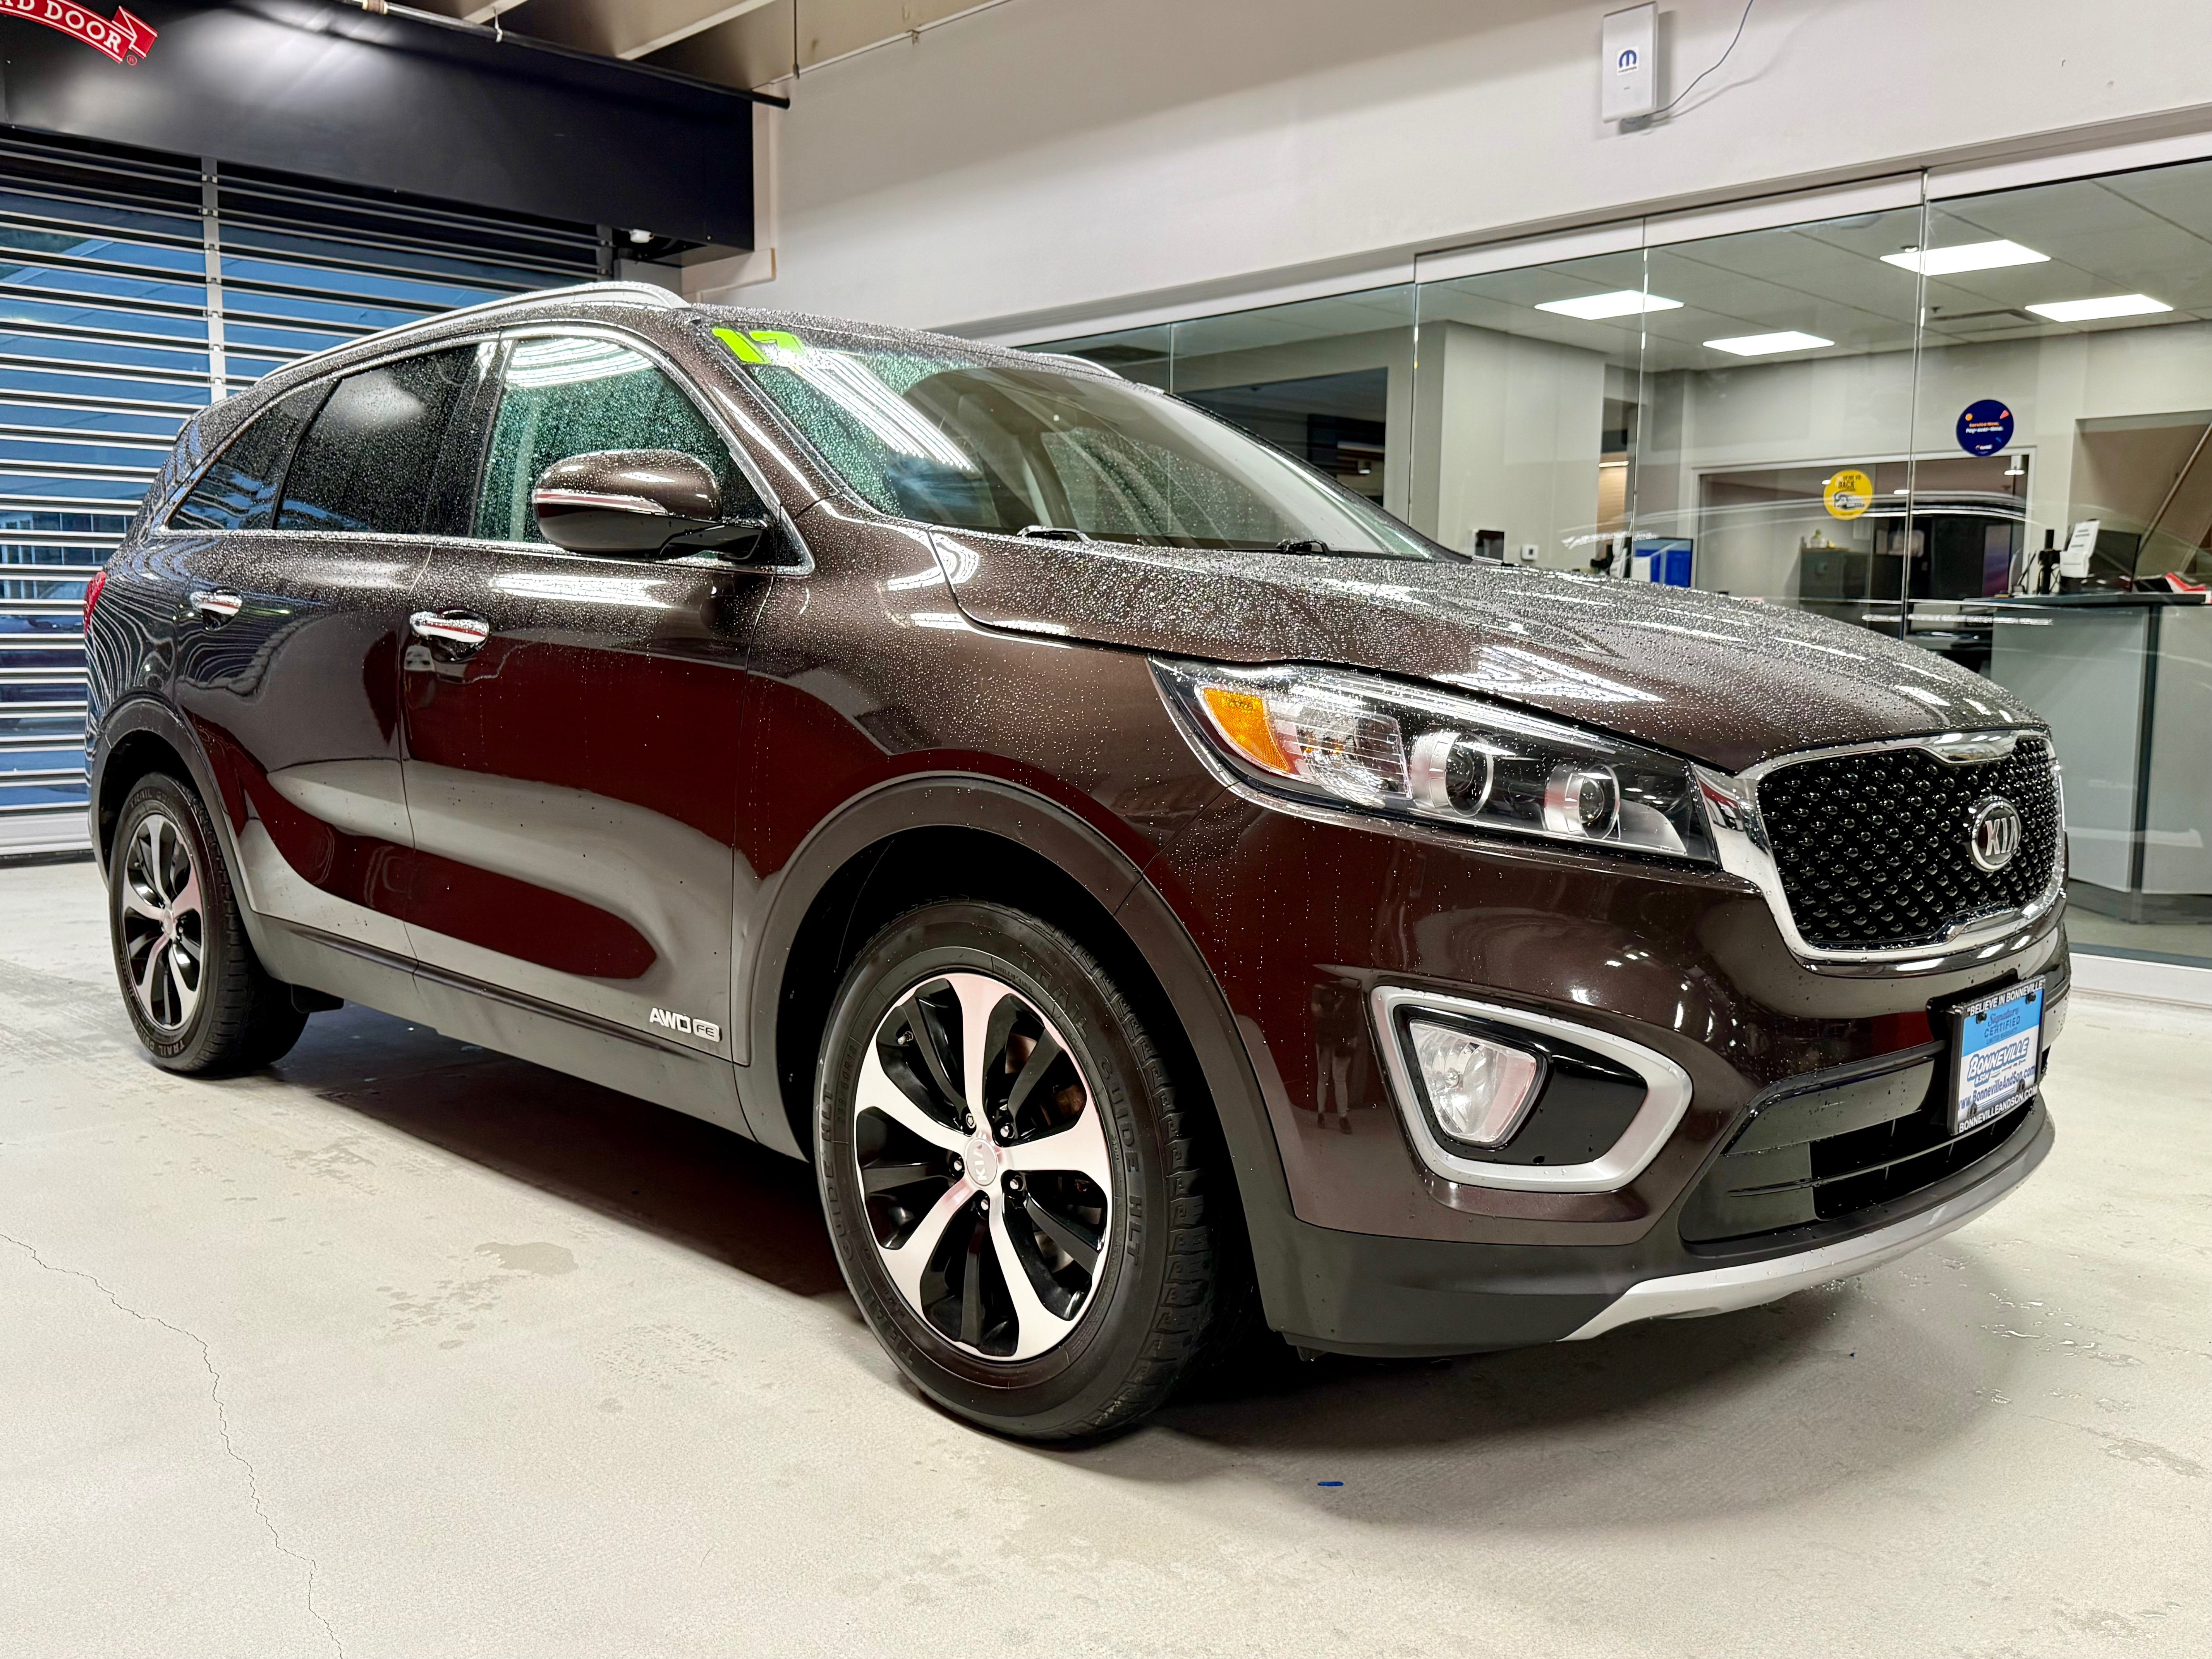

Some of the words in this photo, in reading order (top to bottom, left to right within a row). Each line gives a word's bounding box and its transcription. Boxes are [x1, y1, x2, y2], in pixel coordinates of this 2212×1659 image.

[44, 0, 121, 53] DOOR
[712, 328, 809, 365] 17
[1985, 816, 2018, 856] KIA
[1998, 994, 2006, 1006] IN
[649, 1007, 692, 1034] AWD
[696, 1024, 714, 1037] FE
[1984, 1016, 2021, 1038] CERTIFIED
[1967, 1037, 2030, 1082] BONNEVILLE
[1959, 1085, 2038, 1133] BONNEVILLEANDSON.COM
